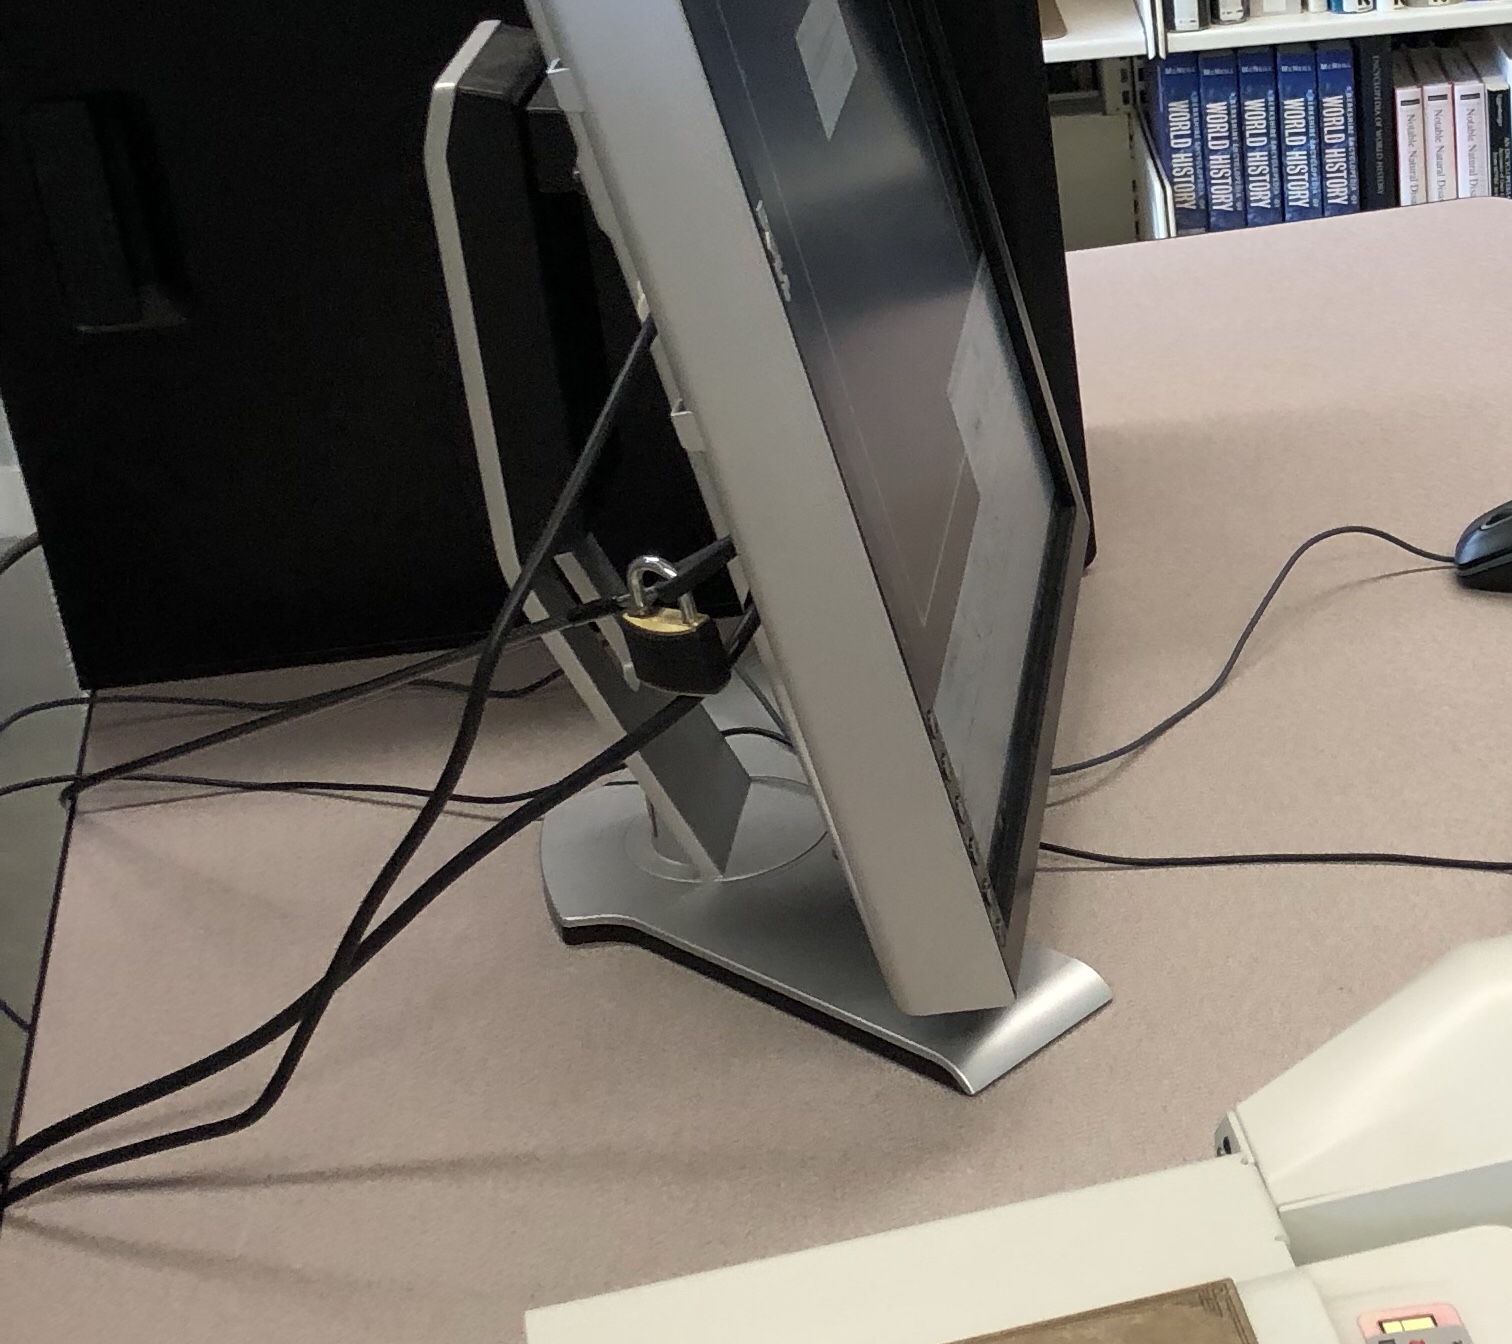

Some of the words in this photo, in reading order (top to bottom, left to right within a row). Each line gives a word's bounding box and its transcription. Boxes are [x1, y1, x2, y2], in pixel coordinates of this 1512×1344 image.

[1284, 98, 1307, 146] WORLD
[1434, 110, 1443, 142] Notable
[1286, 151, 1310, 207] HISTORY
[1436, 145, 1446, 181] Natural
